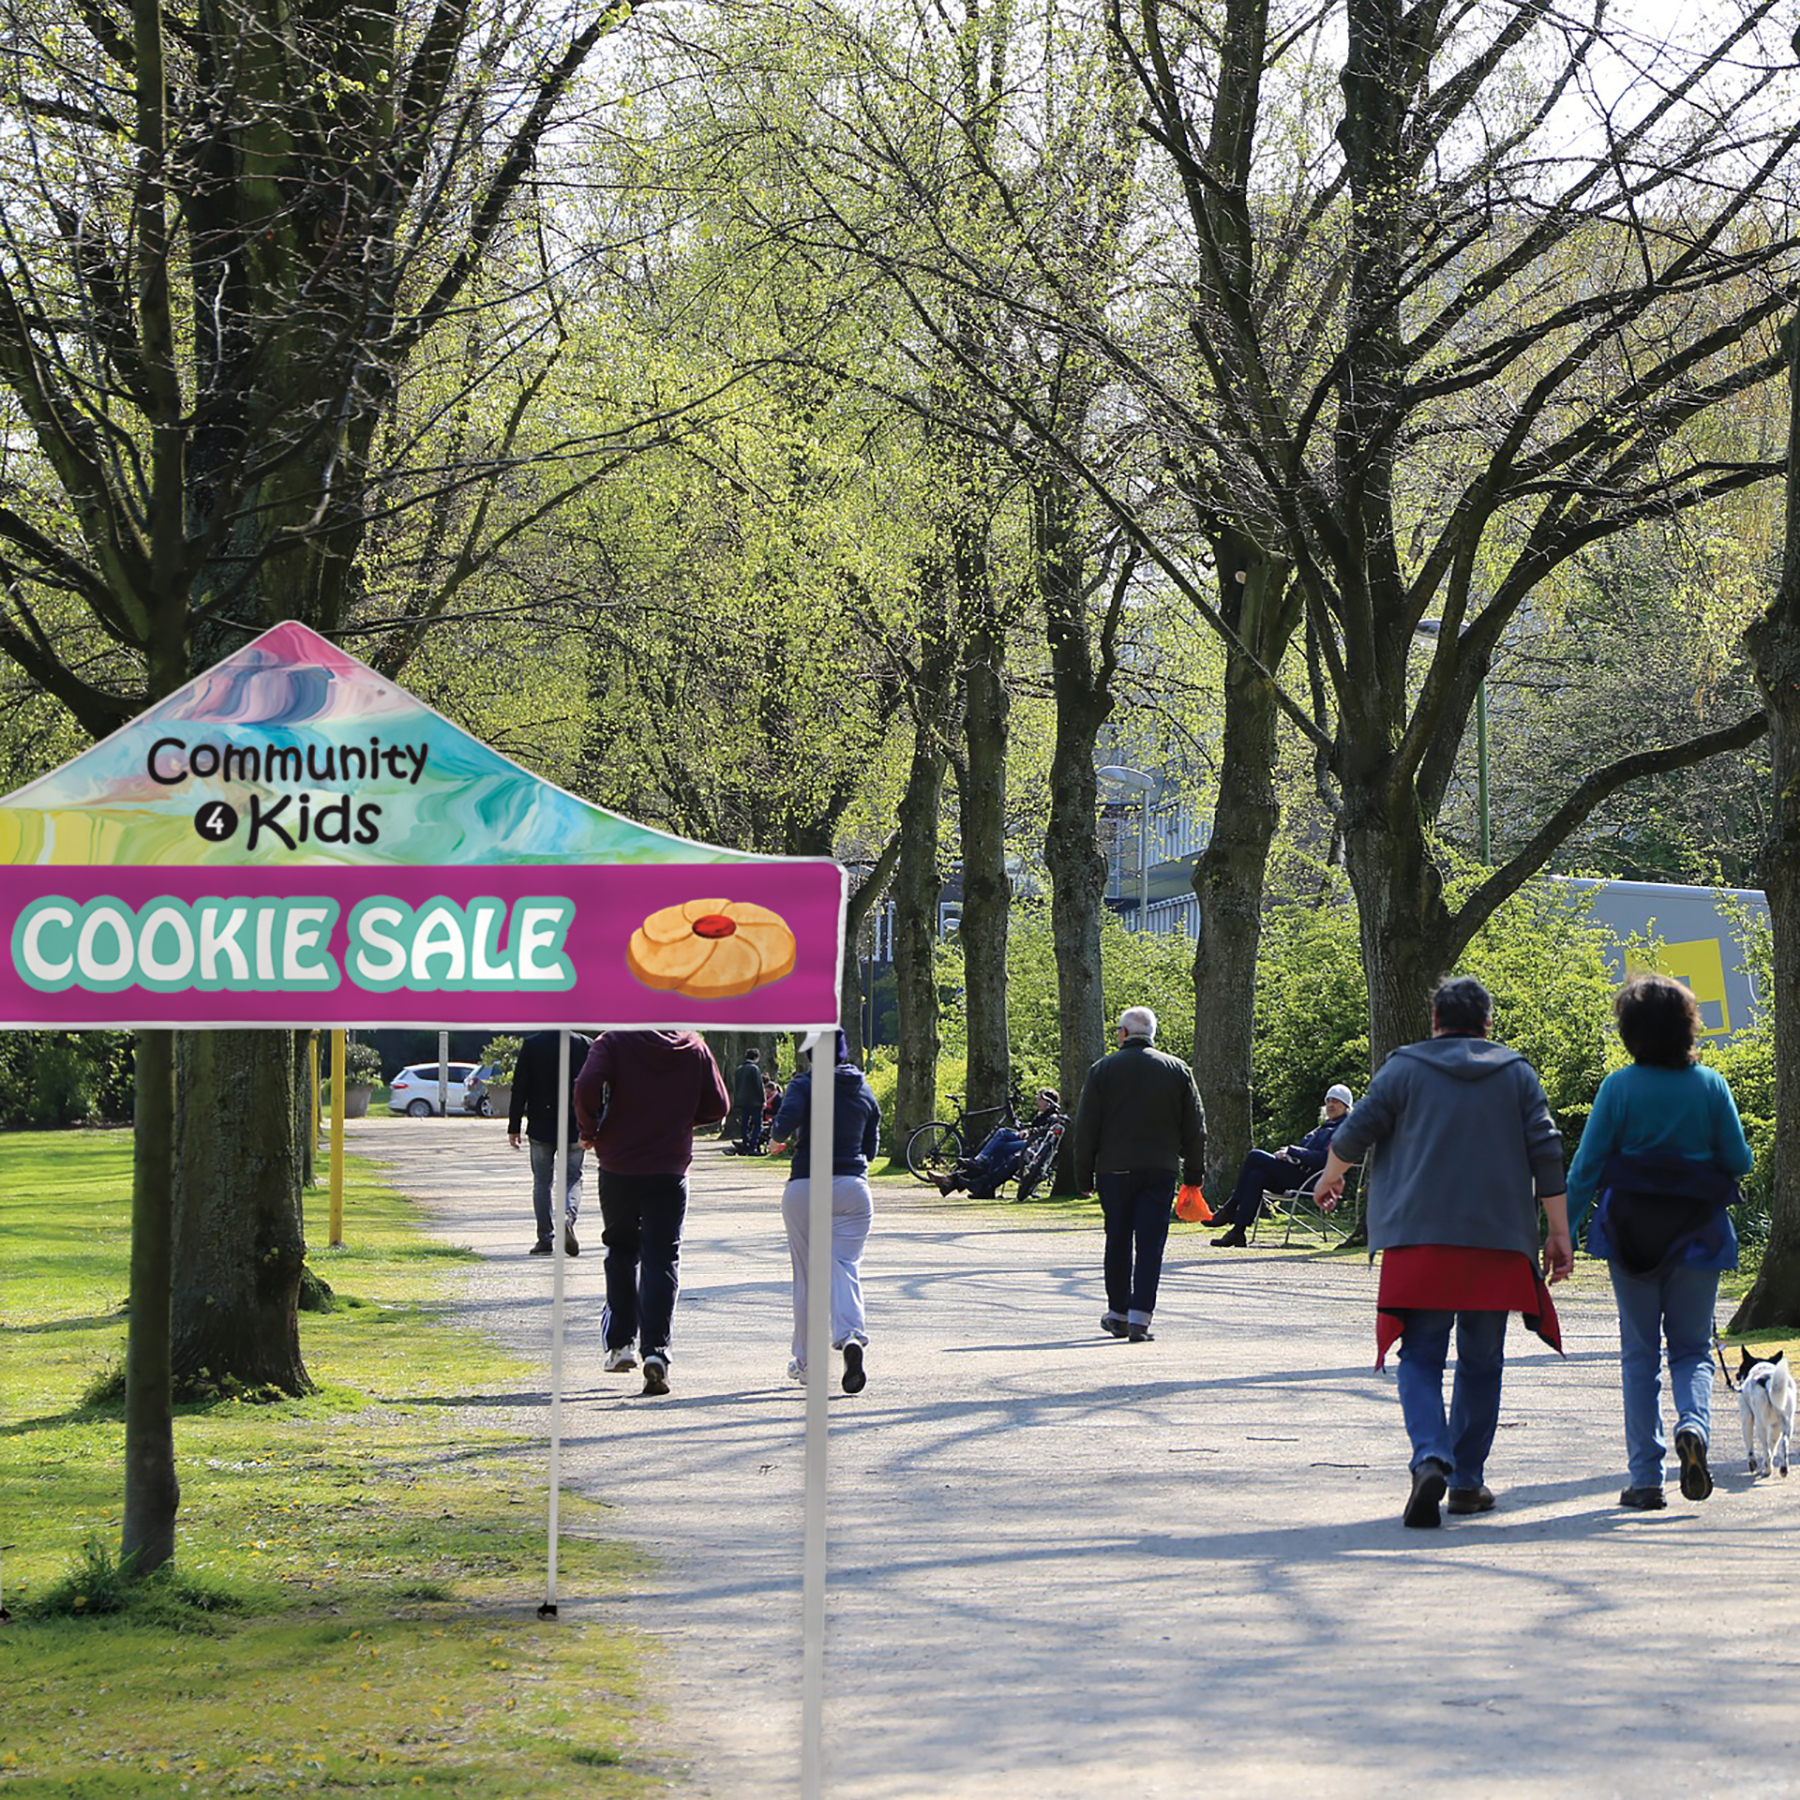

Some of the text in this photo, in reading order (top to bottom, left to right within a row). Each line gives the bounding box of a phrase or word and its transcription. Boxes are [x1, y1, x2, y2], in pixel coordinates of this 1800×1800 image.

[147, 737, 429, 786] Community
[202, 793, 383, 852] 4 Kids
[21, 904, 567, 984] COOKIE SALE
